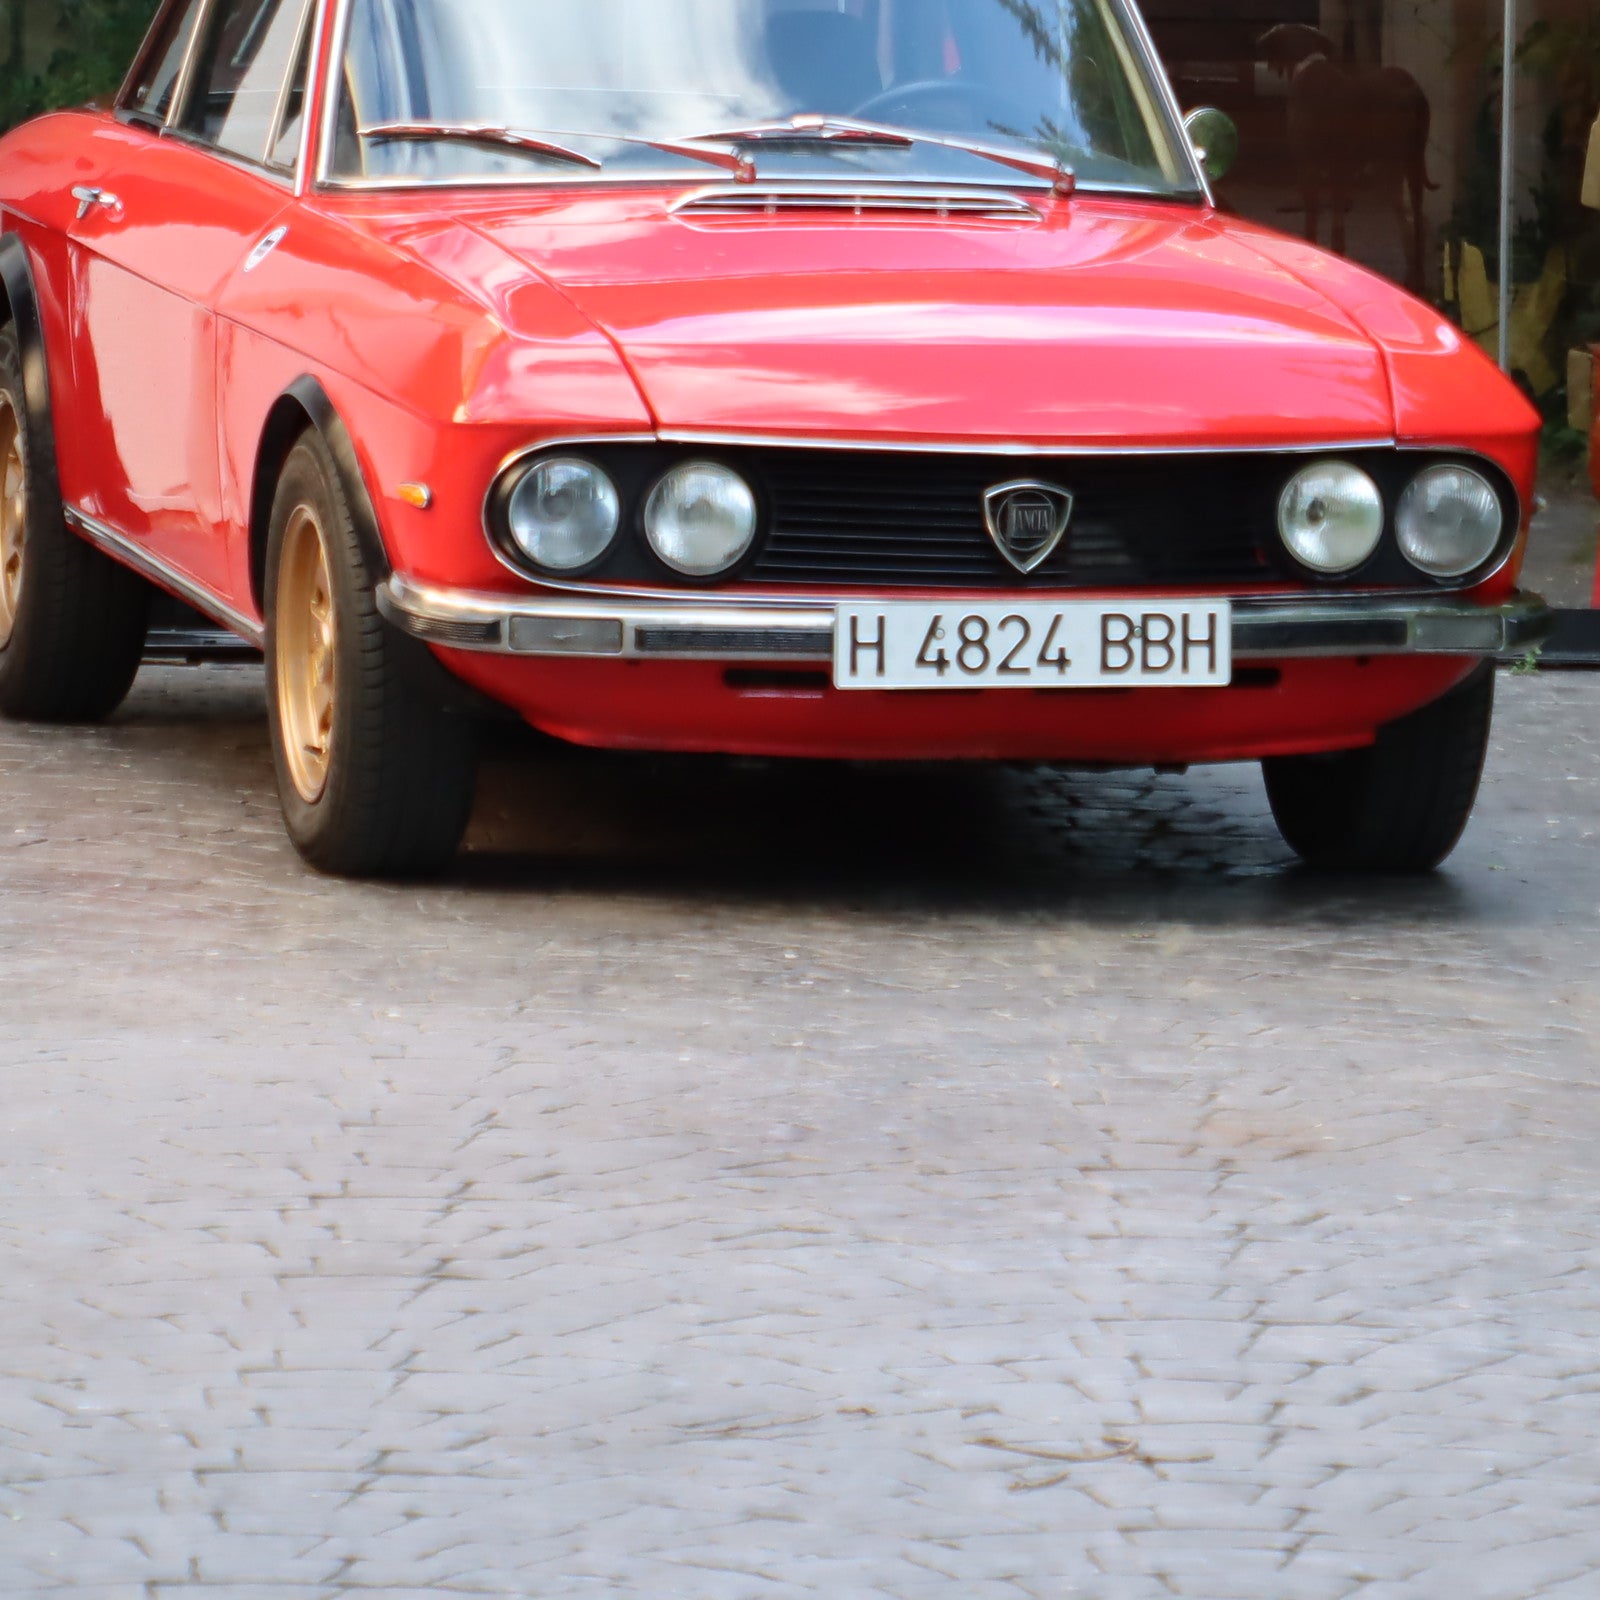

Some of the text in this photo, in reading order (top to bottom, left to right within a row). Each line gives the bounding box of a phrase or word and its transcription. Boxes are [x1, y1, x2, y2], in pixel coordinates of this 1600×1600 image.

[849, 611, 1217, 676] H 4824 BBH
